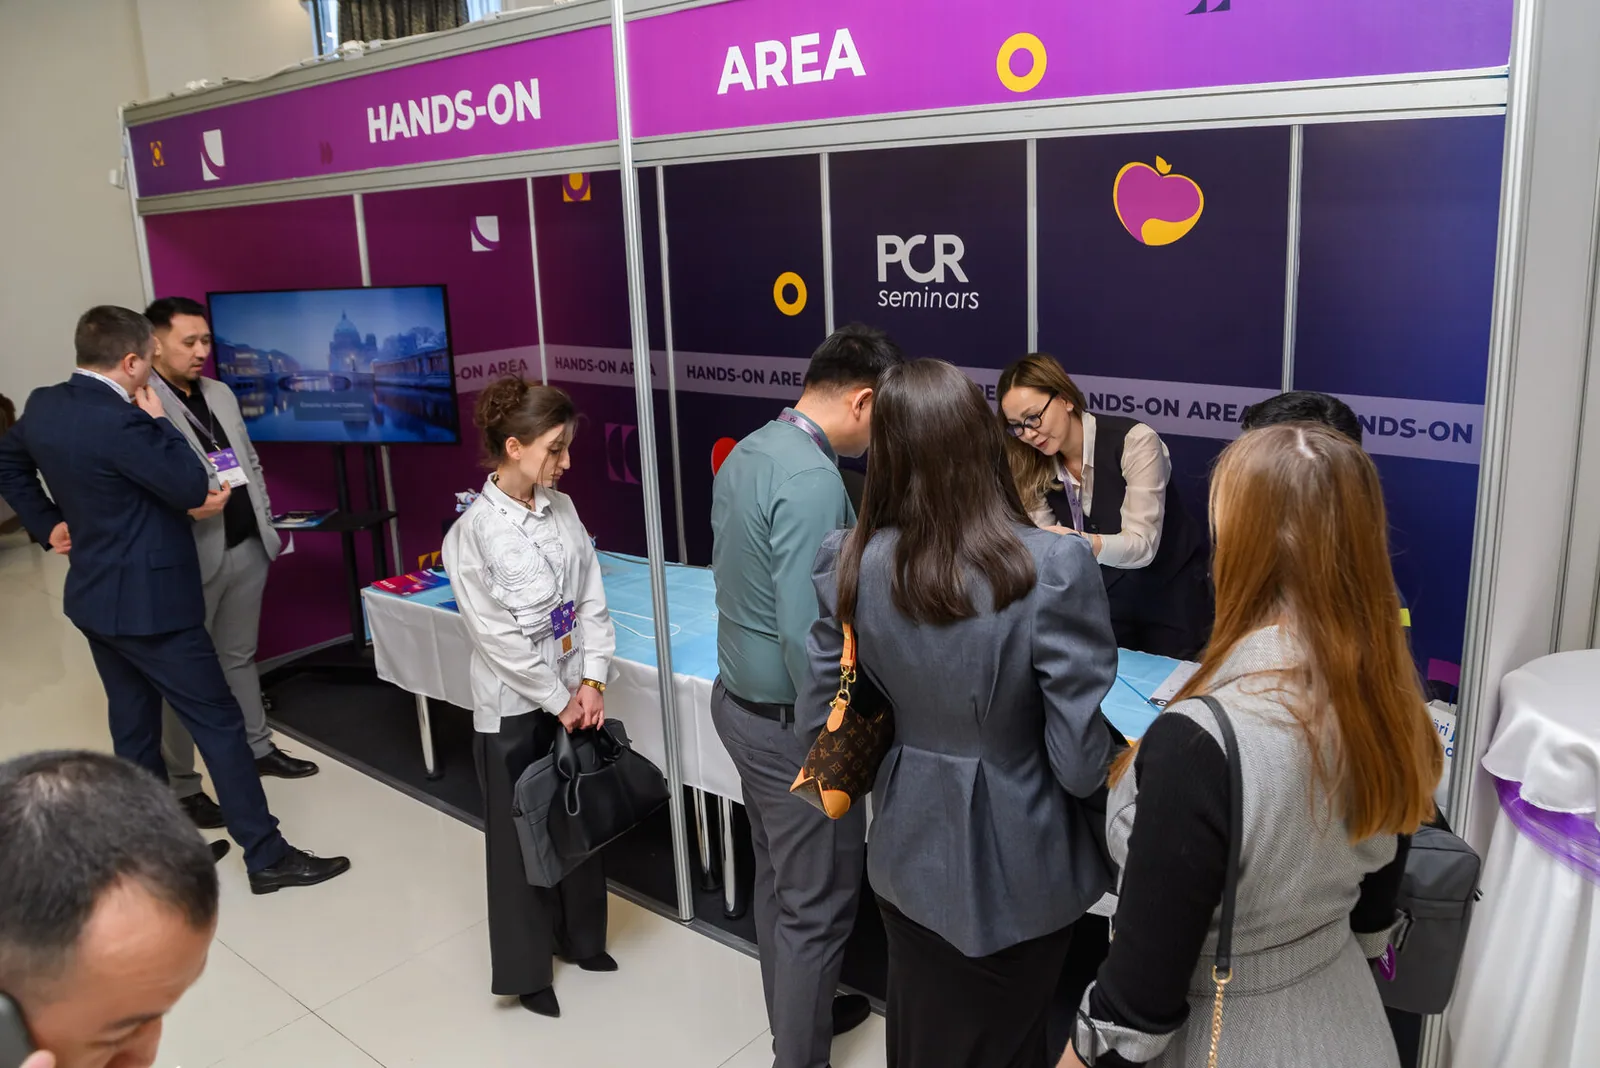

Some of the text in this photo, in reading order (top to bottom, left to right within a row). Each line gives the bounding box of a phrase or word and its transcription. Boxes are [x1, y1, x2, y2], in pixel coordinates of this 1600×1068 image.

[367, 28, 866, 143] HANDS-ON AREA
[877, 234, 969, 283] PCR
[878, 286, 979, 309] seminars
[487, 358, 528, 376] AREA
[555, 356, 617, 374] HANDS-ON
[686, 365, 805, 387] HANDS-ON ARE
[1085, 392, 1180, 417] NDS-ON
[1358, 414, 1473, 444] NDS-ON
